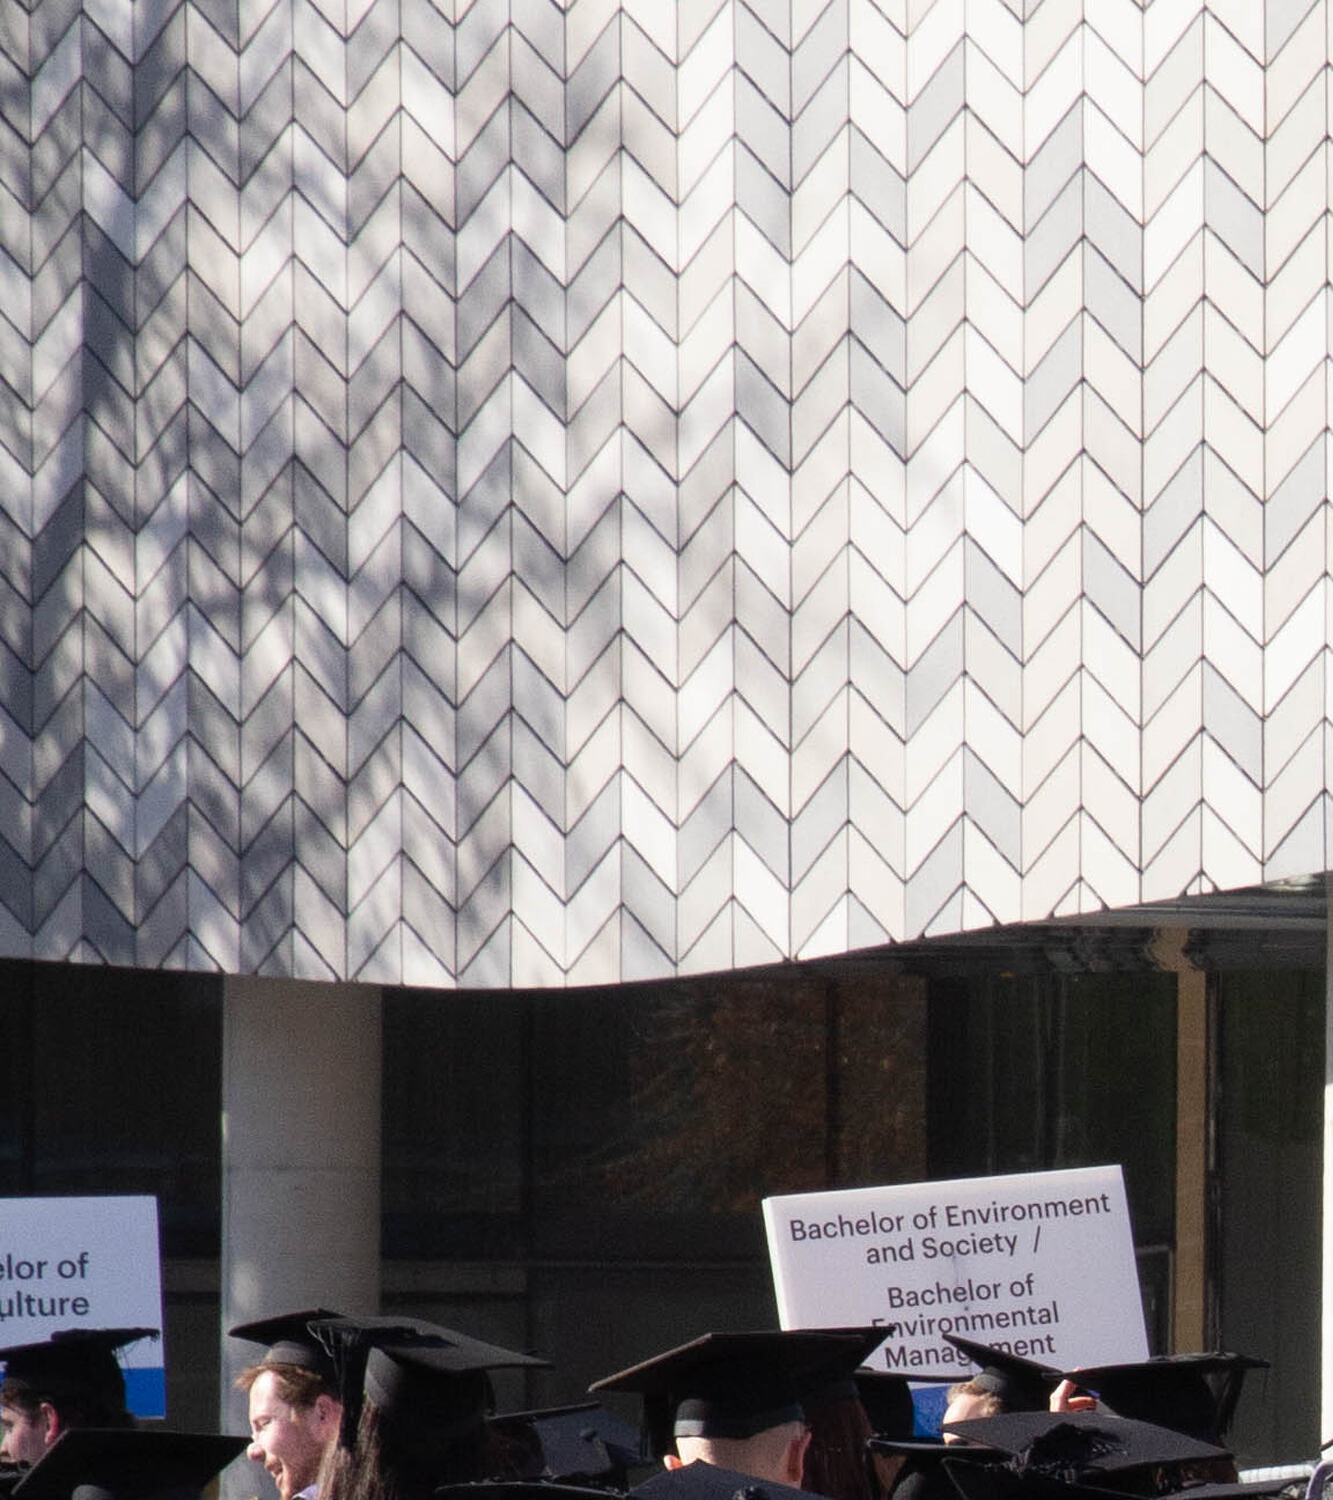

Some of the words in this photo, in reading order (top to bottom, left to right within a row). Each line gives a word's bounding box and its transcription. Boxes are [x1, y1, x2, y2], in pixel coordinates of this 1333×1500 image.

[790, 1210, 904, 1241] Bachelor
[913, 1205, 938, 1229] of
[946, 1193, 1111, 1228] Environment
[866, 1239, 915, 1265] and
[922, 1232, 1018, 1259] Society
[1032, 1226, 1042, 1254] /
[57, 1251, 89, 1279] of
[887, 1277, 1001, 1309] Bachelor
[1010, 1273, 1035, 1297] of
[885, 1334, 1056, 1368] Managment
